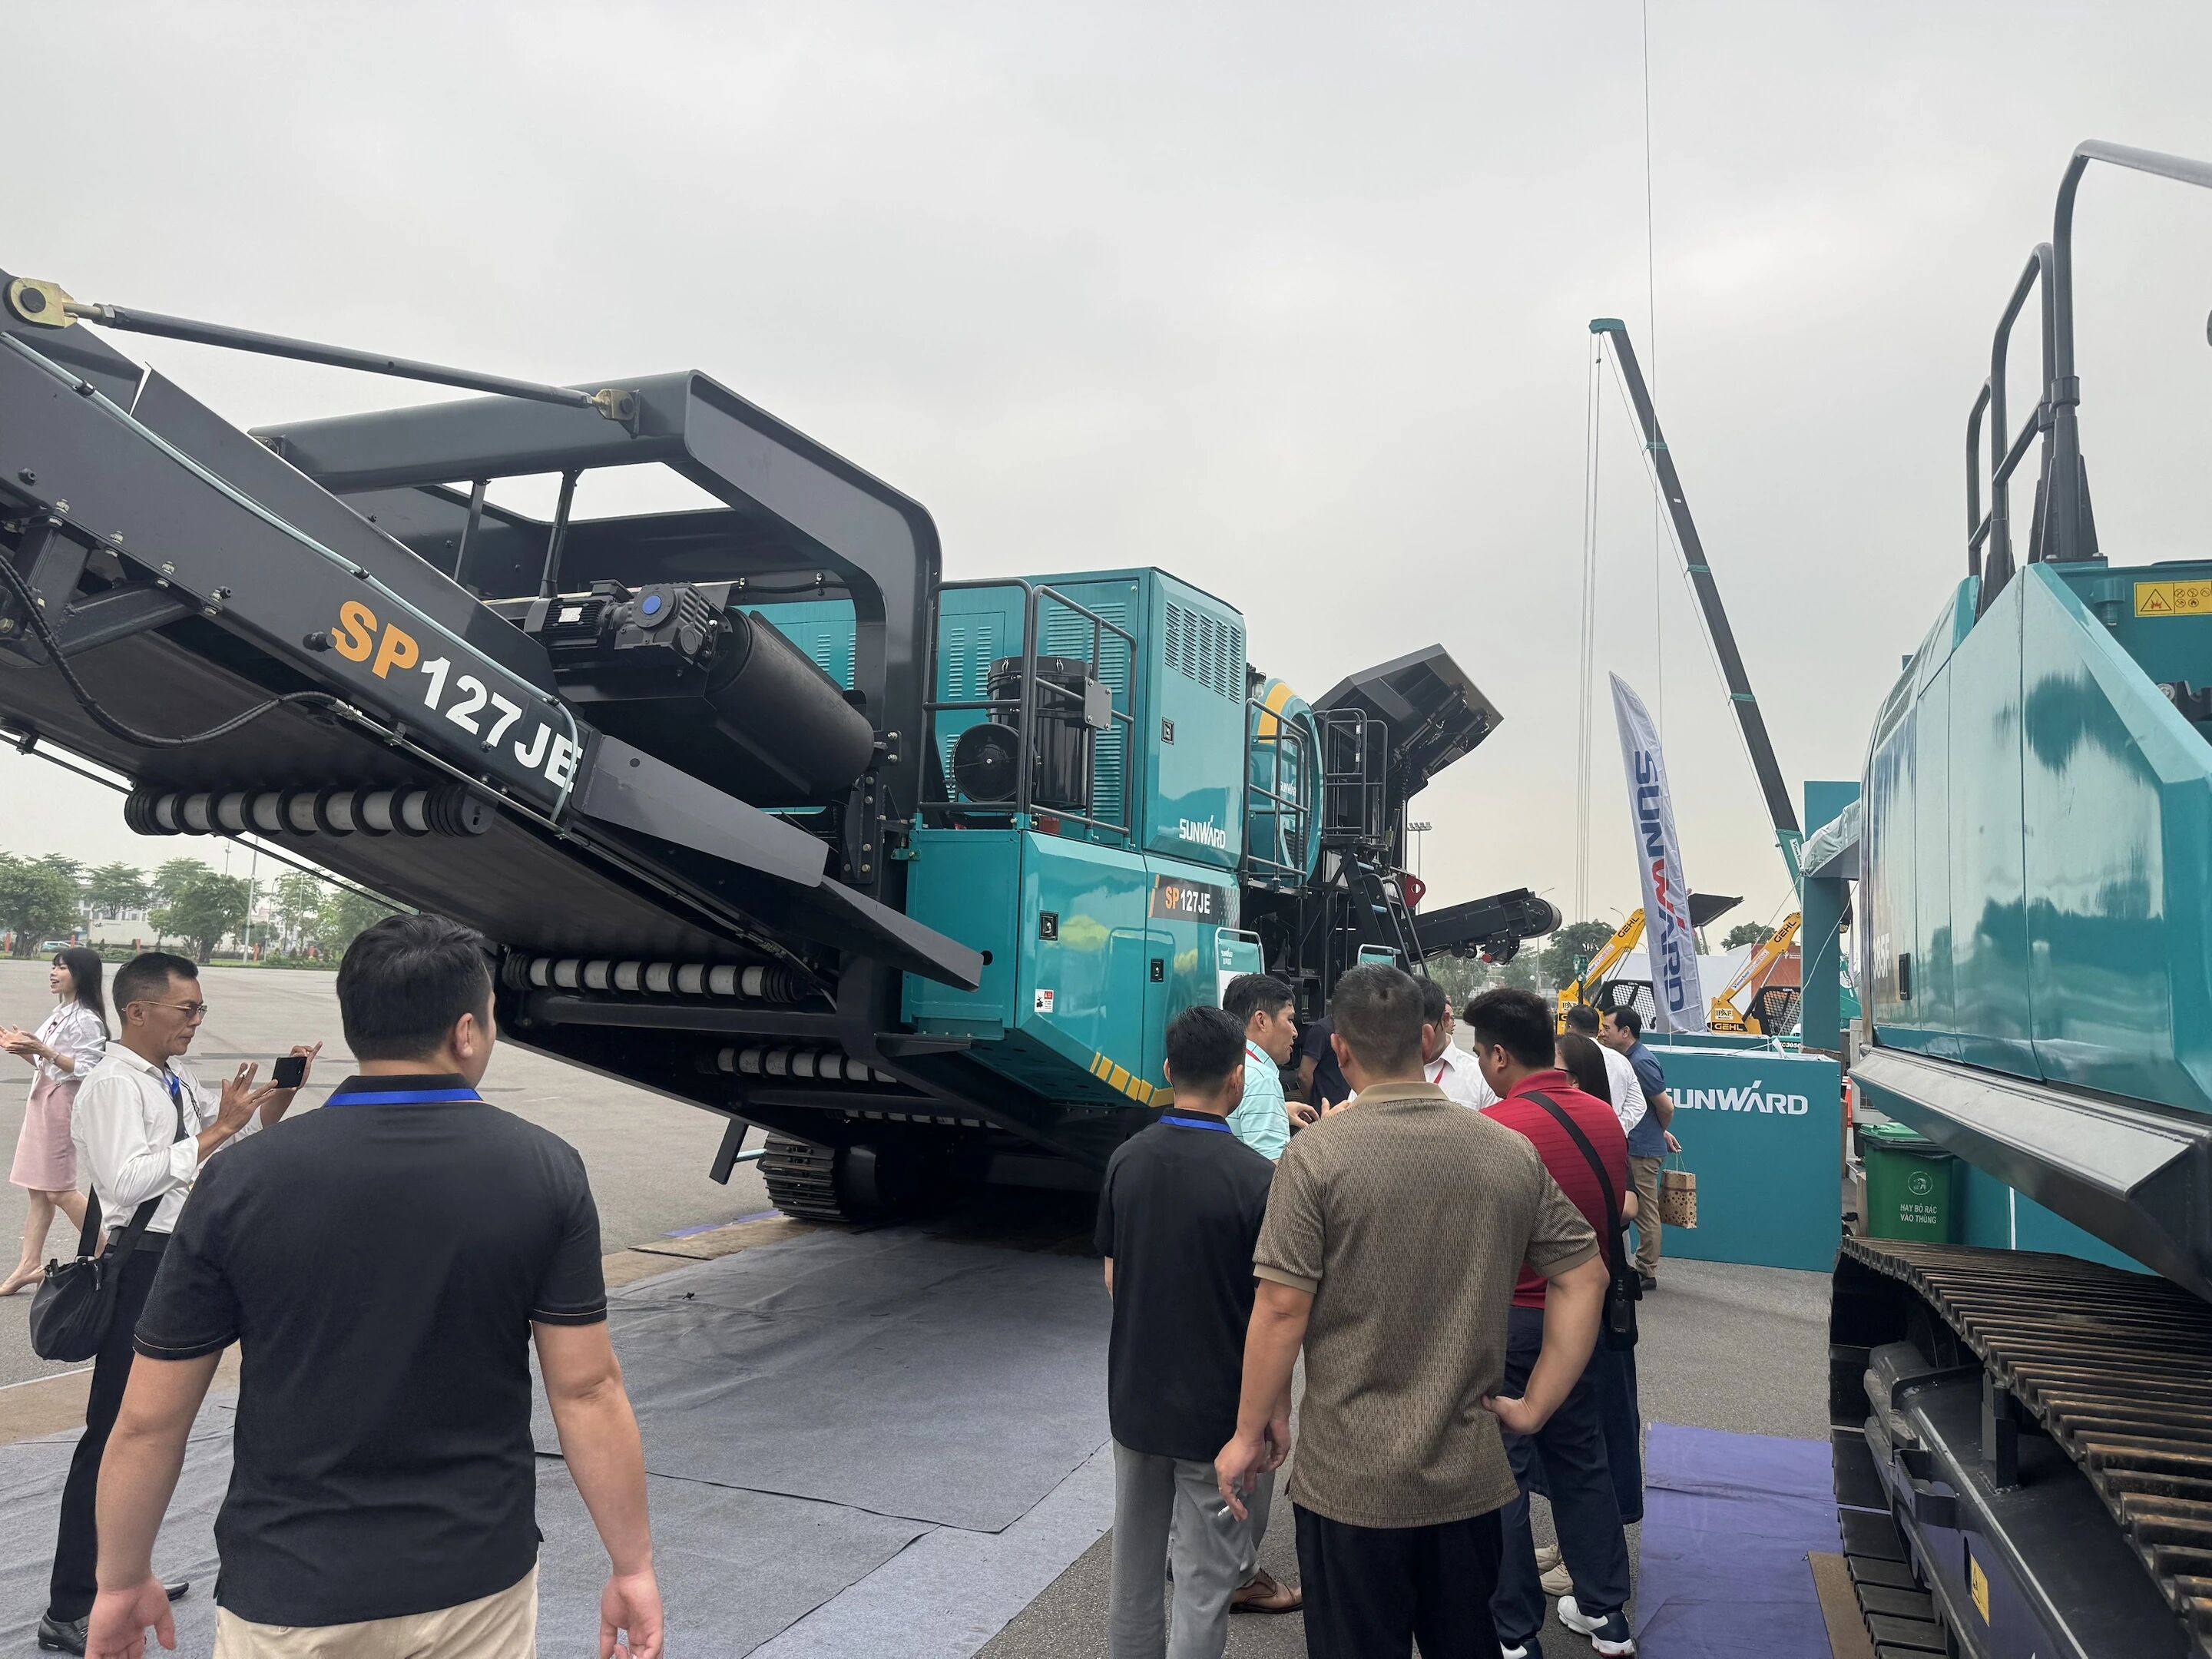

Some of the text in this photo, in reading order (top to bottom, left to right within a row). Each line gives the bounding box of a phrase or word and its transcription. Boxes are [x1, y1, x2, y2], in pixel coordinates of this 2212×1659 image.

[332, 601, 583, 793] SP127JE
[1179, 814, 1226, 849] SUNWARD
[1634, 750, 1686, 1012] SUNWARD
[1618, 917, 1640, 938] GEHL
[1774, 922, 1797, 942] GEHL
